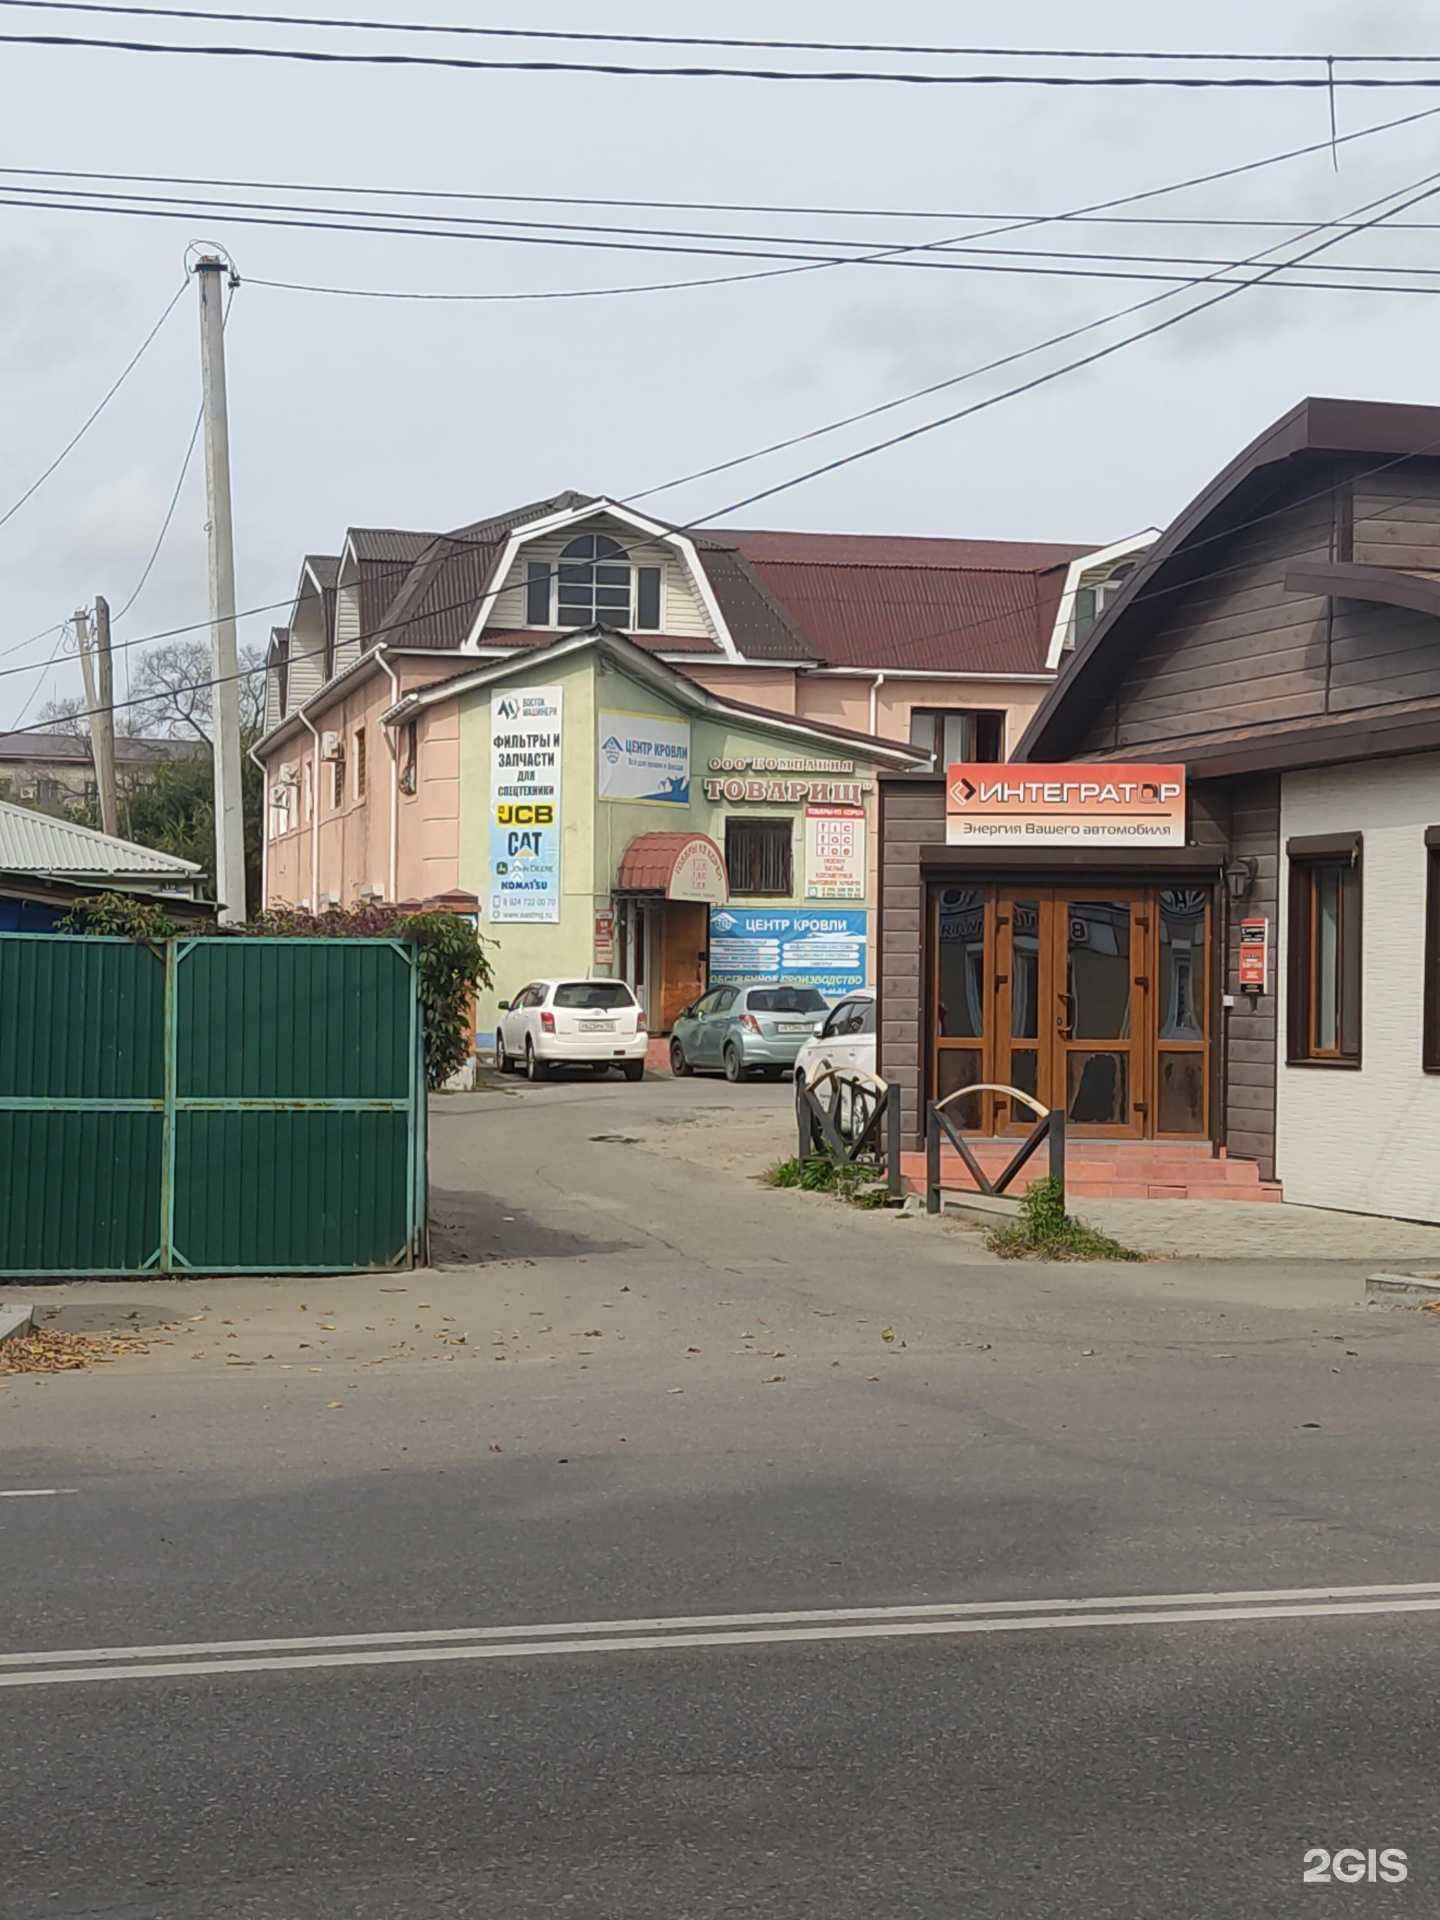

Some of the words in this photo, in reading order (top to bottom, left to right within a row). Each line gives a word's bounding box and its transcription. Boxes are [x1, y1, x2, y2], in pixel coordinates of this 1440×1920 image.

[493, 734, 551, 748] ФИЛЬТРЫ
[553, 734, 560, 747] И
[625, 739, 653, 756] ЦЕНТР
[654, 743, 688, 759] КРОВЛИ
[498, 753, 555, 767] ЗАПЧАСТИ
[709, 758, 746, 770] ООО
[517, 770, 536, 781] ДЛЯ
[498, 785, 555, 797] СПЕЦТЕХНИКИ
[979, 783, 1181, 803] ИНТЕГРАТОР
[498, 805, 554, 824] JCB
[963, 822, 1022, 836] Энергия
[1026, 823, 1080, 836] Вашего
[1083, 822, 1171, 836] автомобиля
[507, 832, 542, 857] CAT
[501, 880, 548, 890] KOMATSU
[746, 919, 790, 932] ЦЕНТР
[793, 919, 847, 931] КРОВЛИ
